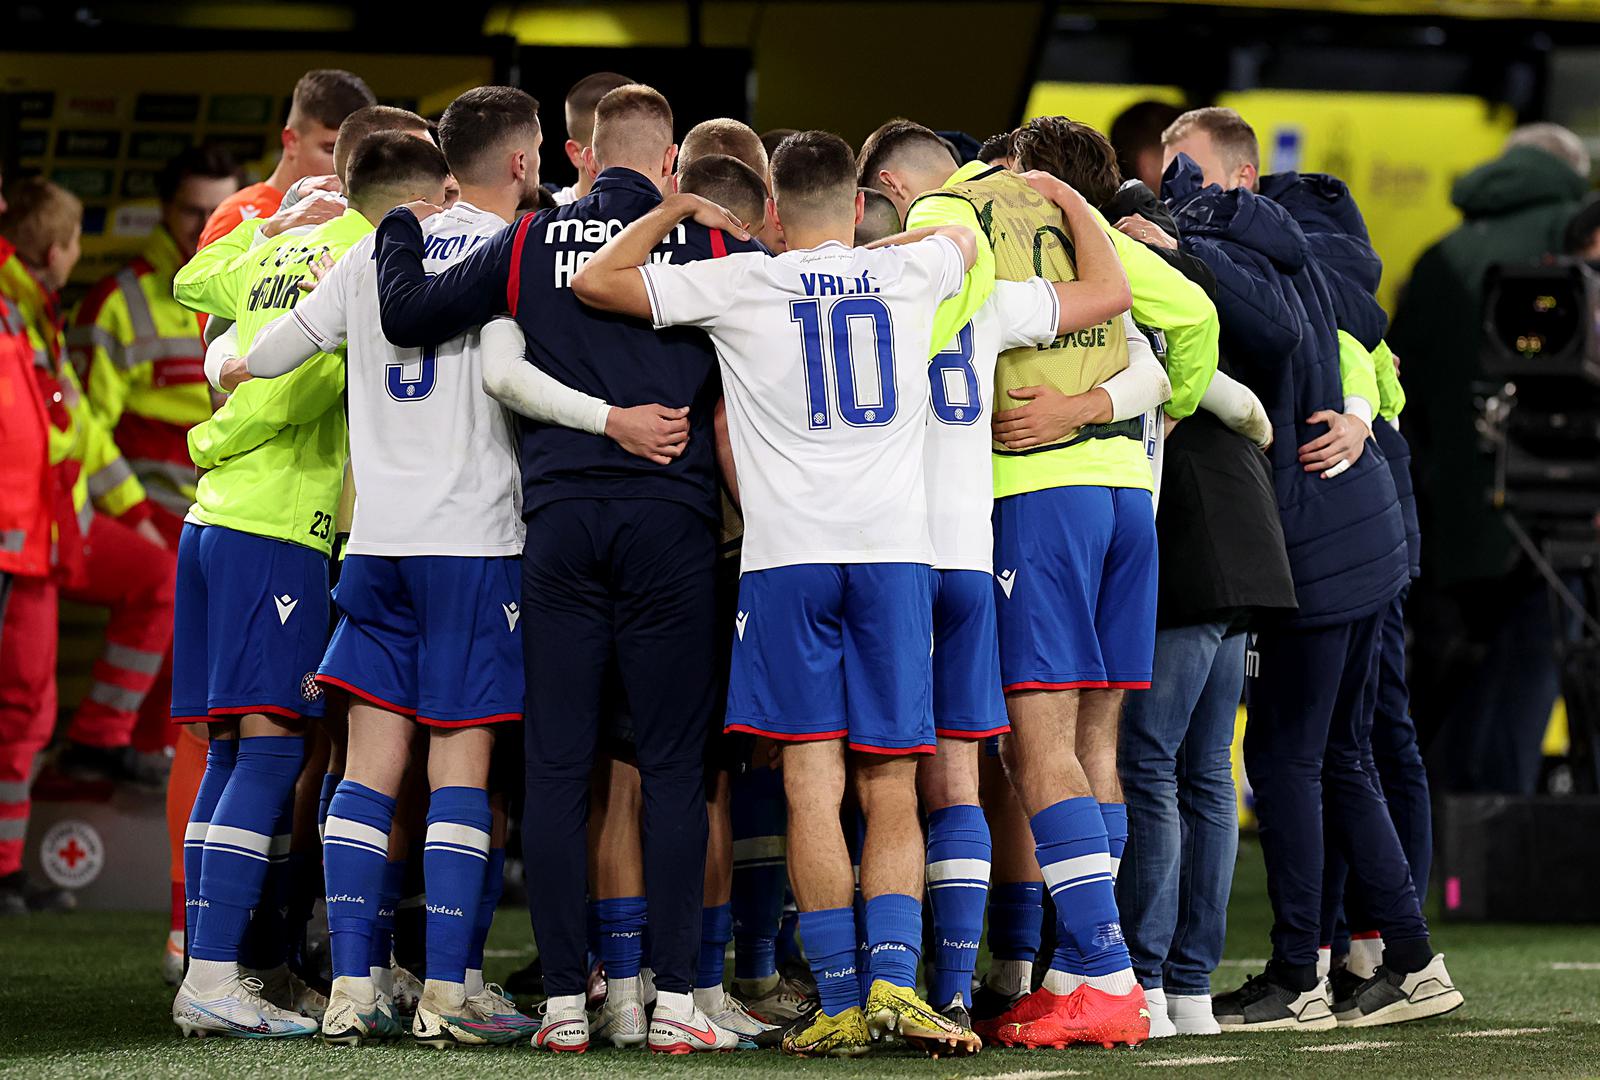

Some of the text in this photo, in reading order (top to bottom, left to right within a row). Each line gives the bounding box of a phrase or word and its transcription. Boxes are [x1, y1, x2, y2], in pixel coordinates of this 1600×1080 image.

[544, 219, 687, 244] macn
[789, 295, 900, 430] 10
[309, 510, 332, 540] 23
[556, 1029, 585, 1037] TIEMPO
